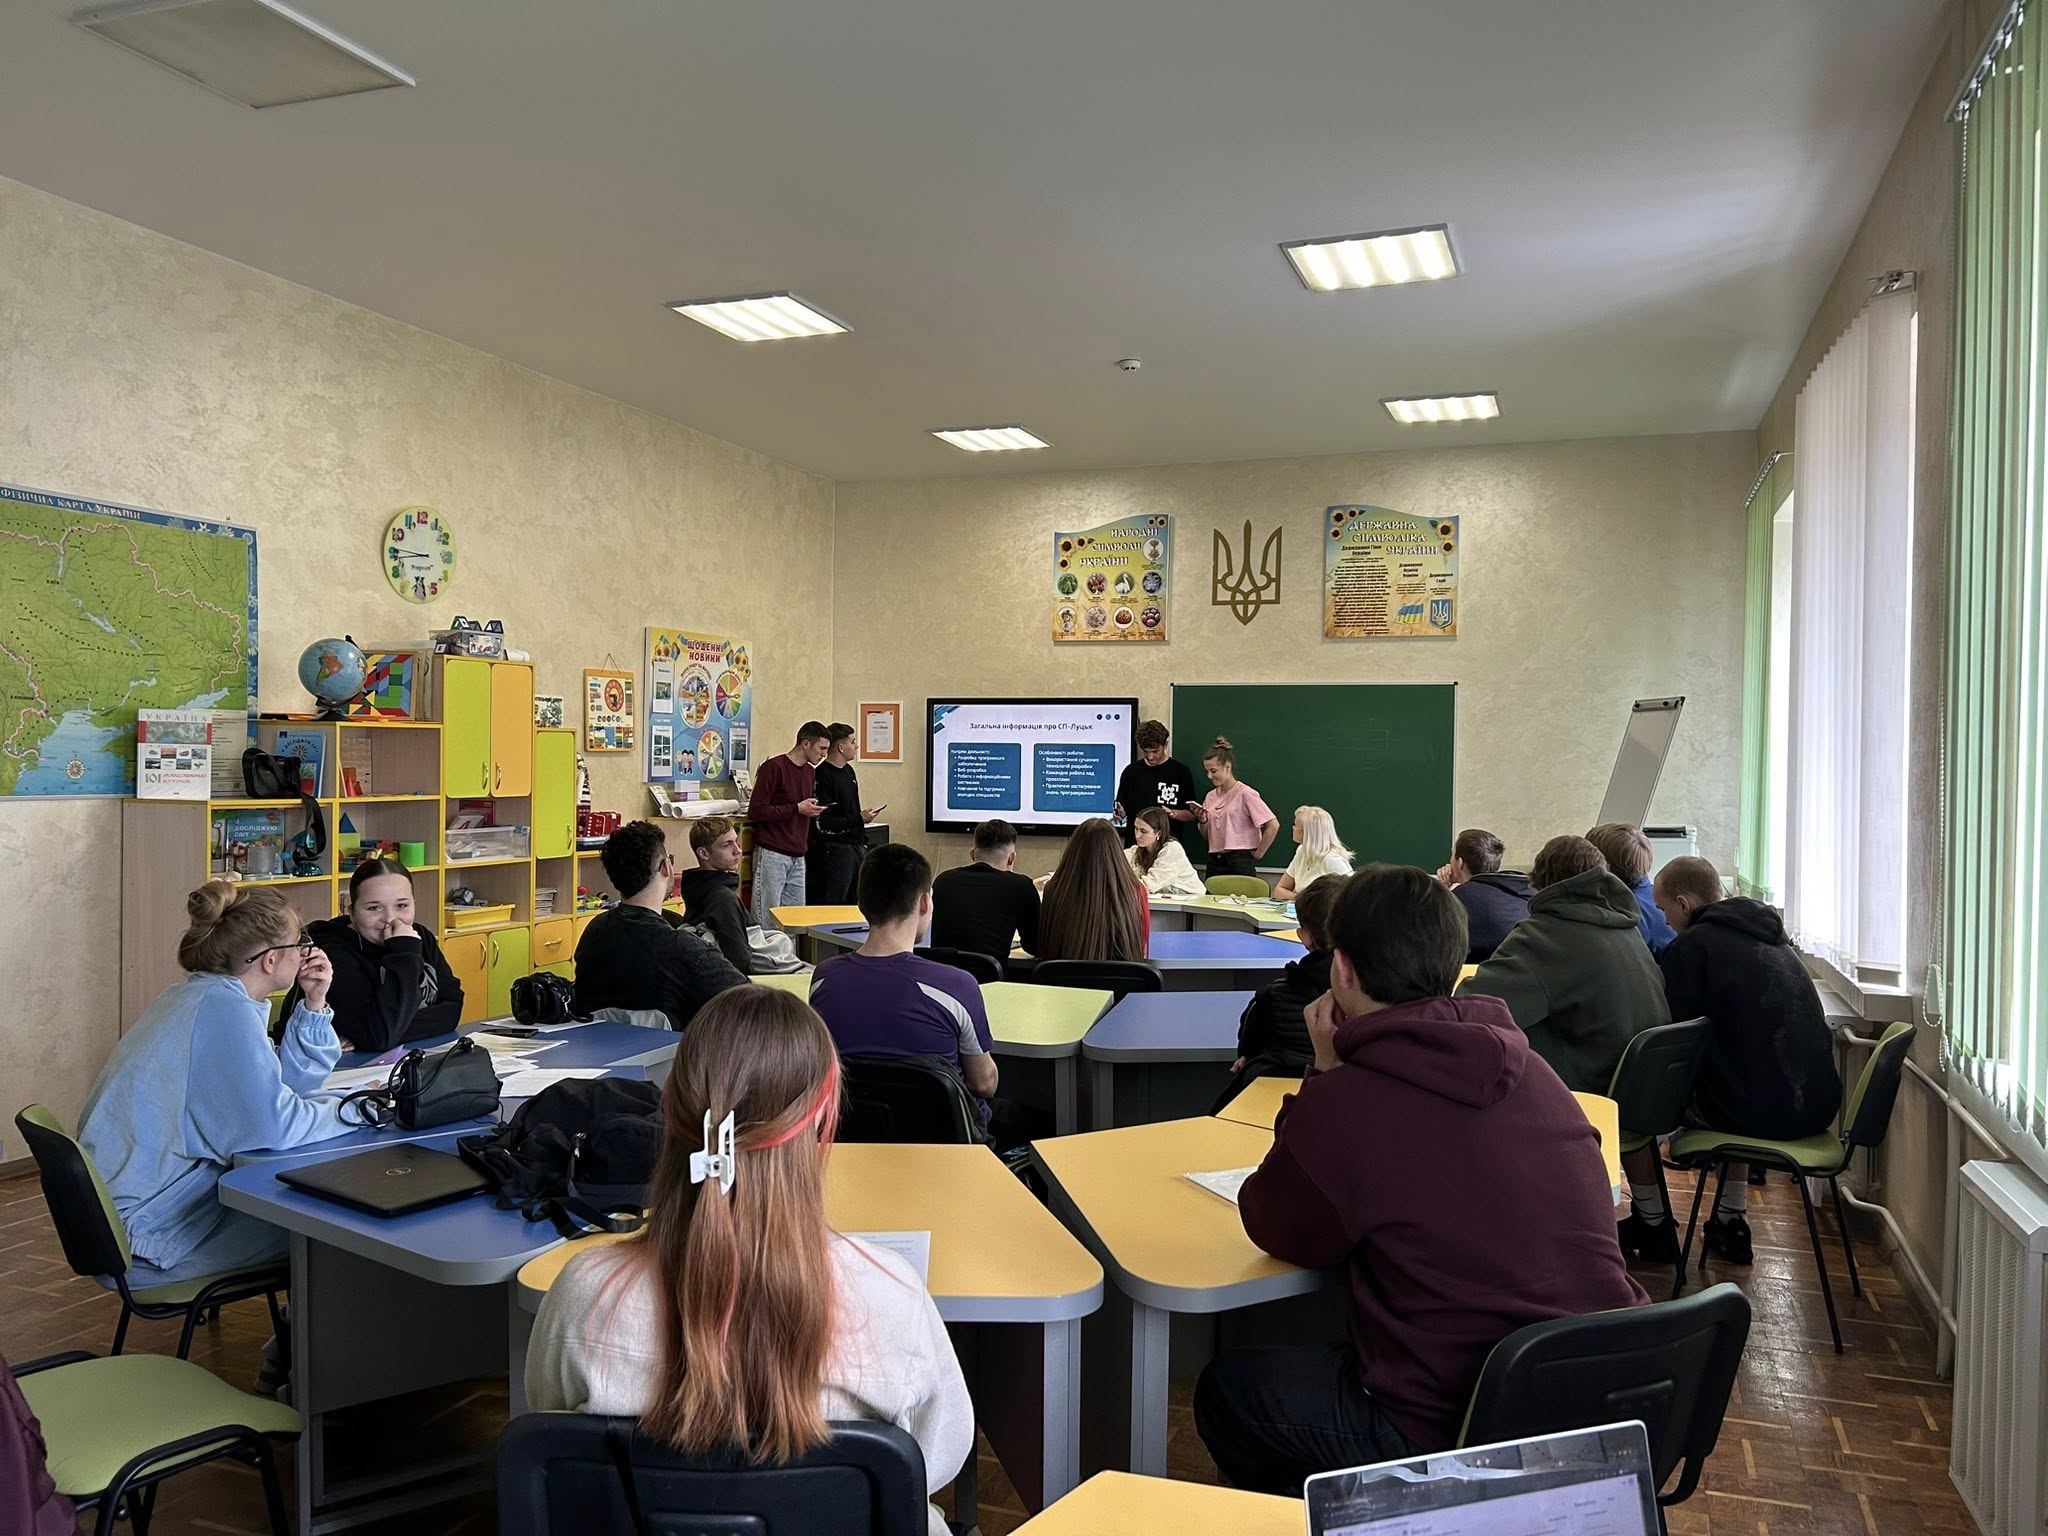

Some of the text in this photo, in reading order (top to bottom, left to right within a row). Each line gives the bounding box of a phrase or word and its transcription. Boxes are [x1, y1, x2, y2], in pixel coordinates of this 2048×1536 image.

[1, 488, 141, 520] ФІЗИЧНА КАРТА УКРАЇНИ
[417, 511, 428, 525] 12
[1348, 520, 1417, 531] ДЕРЖАВНА
[392, 527, 405, 542] 10
[1111, 528, 1159, 538] НАРОДНІ
[1352, 533, 1426, 543] СИМВОЛІКА
[1091, 542, 1141, 552] СИМВОЛИ
[1386, 544, 1438, 555] УКРАЇНИ
[1080, 555, 1128, 568] УКРАЇНИ
[687, 640, 723, 652] ЩОДЕННІ
[688, 652, 721, 663] НОВИНИ
[146, 713, 207, 722] УКРАЇНА
[1002, 723, 1042, 732] інформація
[145, 773, 161, 783] 101
